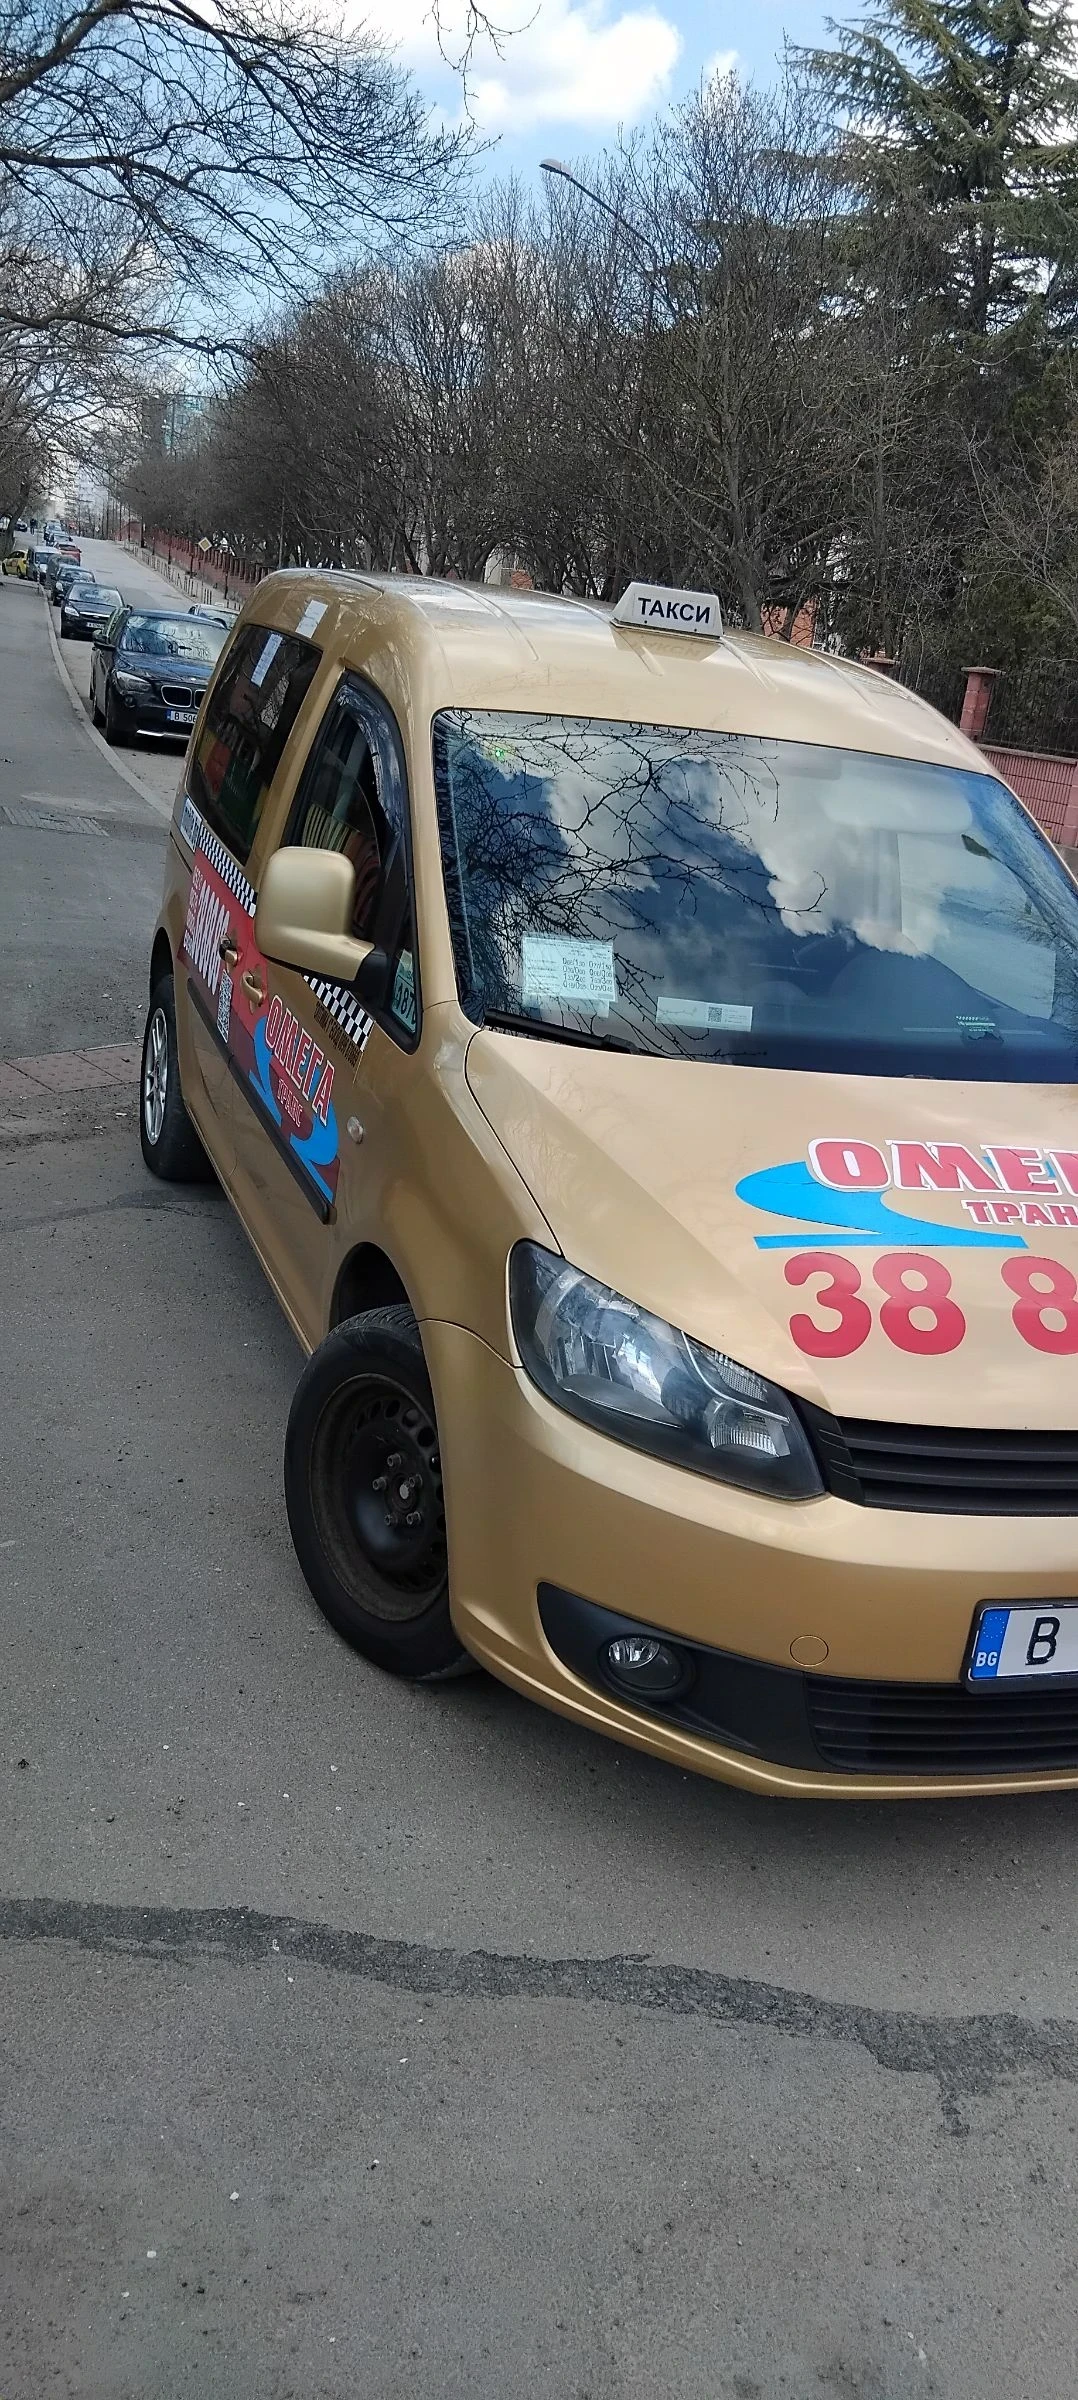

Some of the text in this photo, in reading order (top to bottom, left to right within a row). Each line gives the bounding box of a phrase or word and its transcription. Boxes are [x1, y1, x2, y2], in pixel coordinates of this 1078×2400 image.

[637, 597, 711, 624] ТАКСИ
[265, 994, 335, 1127] ОМЕГА
[785, 1252, 966, 1358] 38
[975, 1651, 998, 1667] BG
